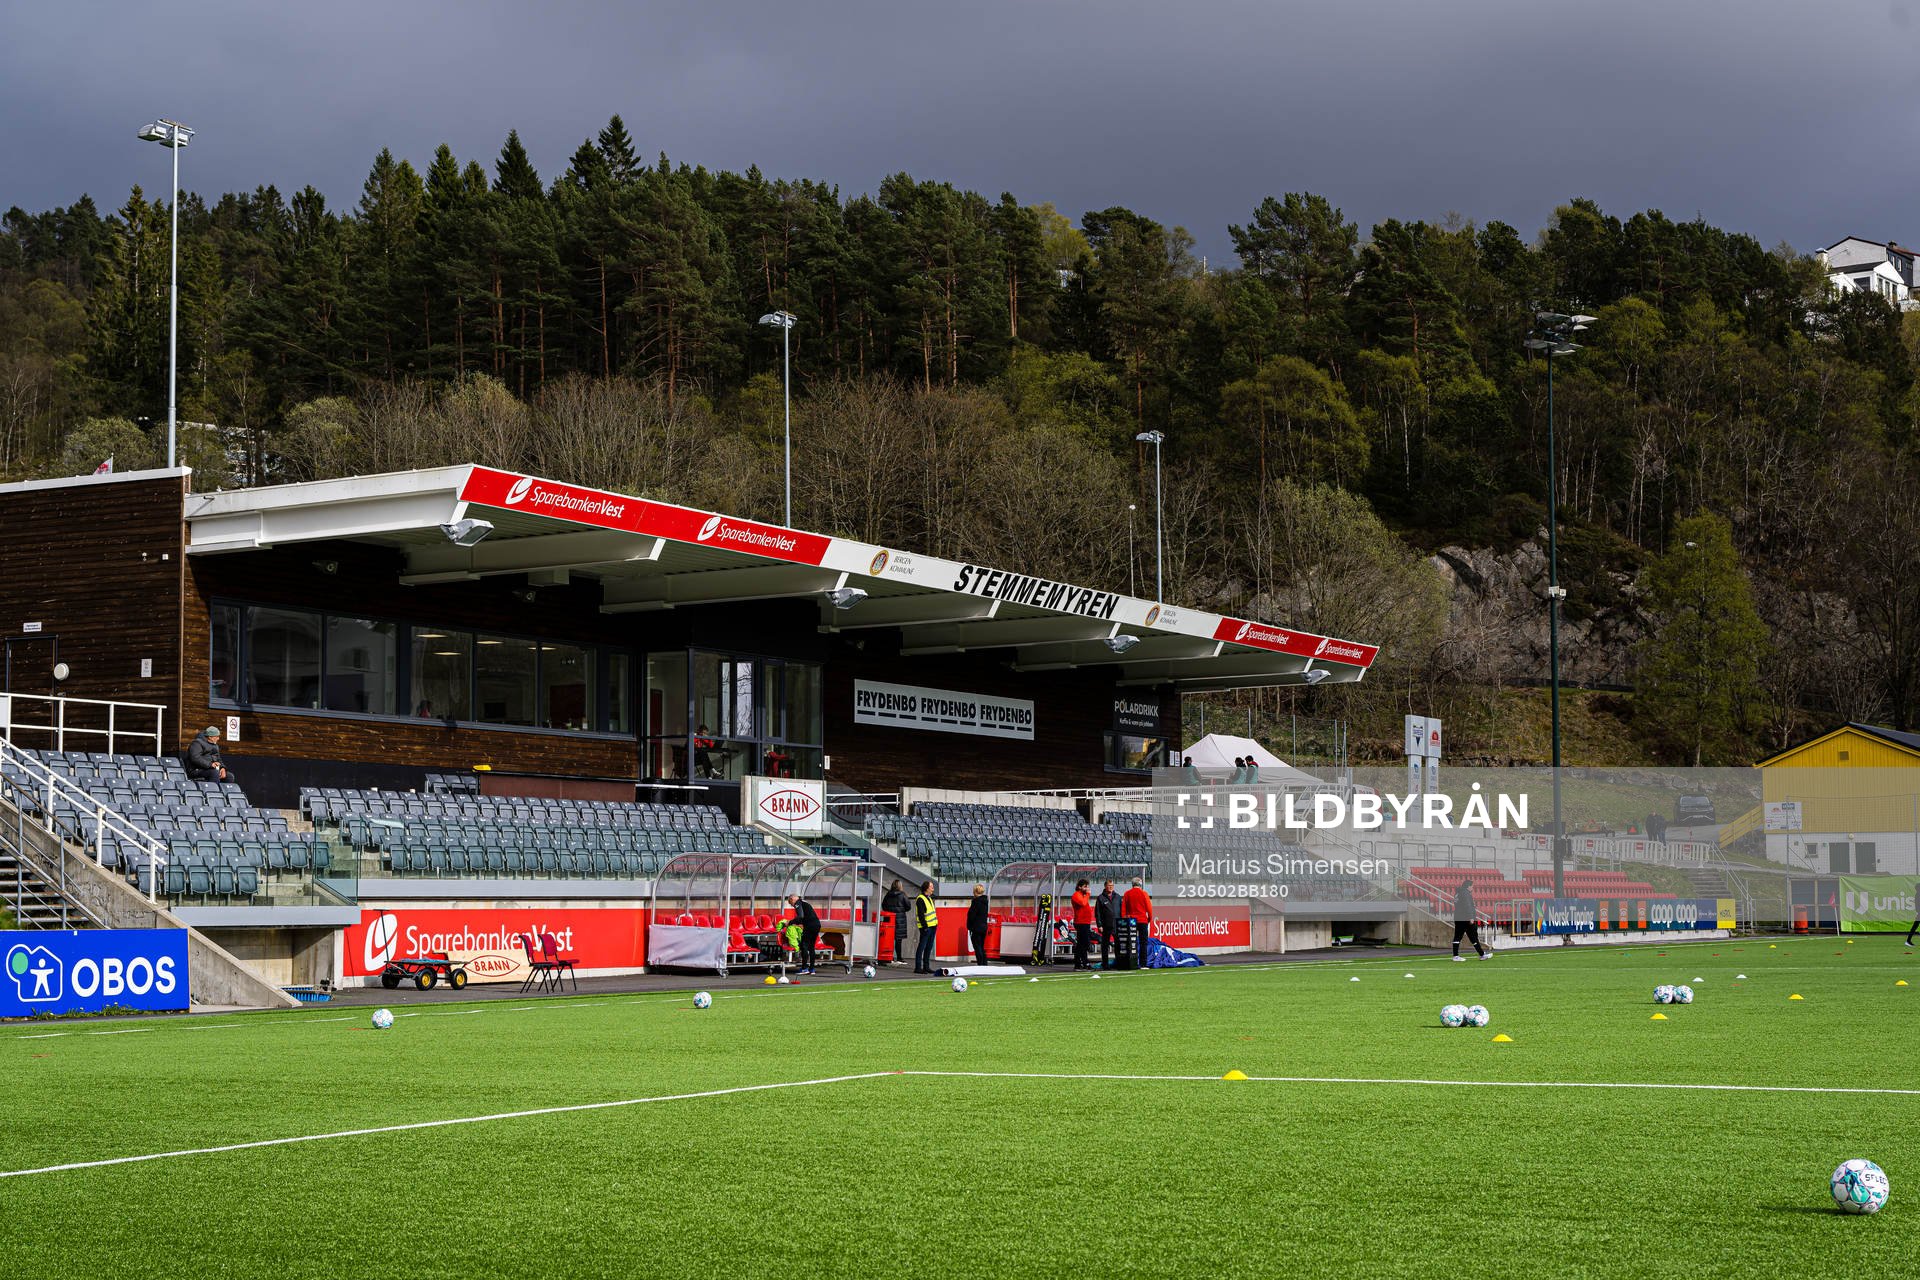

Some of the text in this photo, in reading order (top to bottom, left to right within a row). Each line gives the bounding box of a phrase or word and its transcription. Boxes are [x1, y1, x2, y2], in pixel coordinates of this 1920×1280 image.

[530, 486, 625, 519] SparebankenVest
[717, 523, 797, 552] SparebankenVest
[953, 565, 1121, 620] STEMMEMYREN
[857, 689, 1032, 726] FRYDENBØ FRYDENBØ FRYDENBØ
[771, 797, 810, 814] BRANN
[1153, 916, 1230, 942] SparebankenVest
[1548, 905, 1569, 927] Norsk
[1570, 905, 1595, 931] Tipping
[71, 955, 176, 998] OBOS
[474, 959, 511, 973] BRANN
